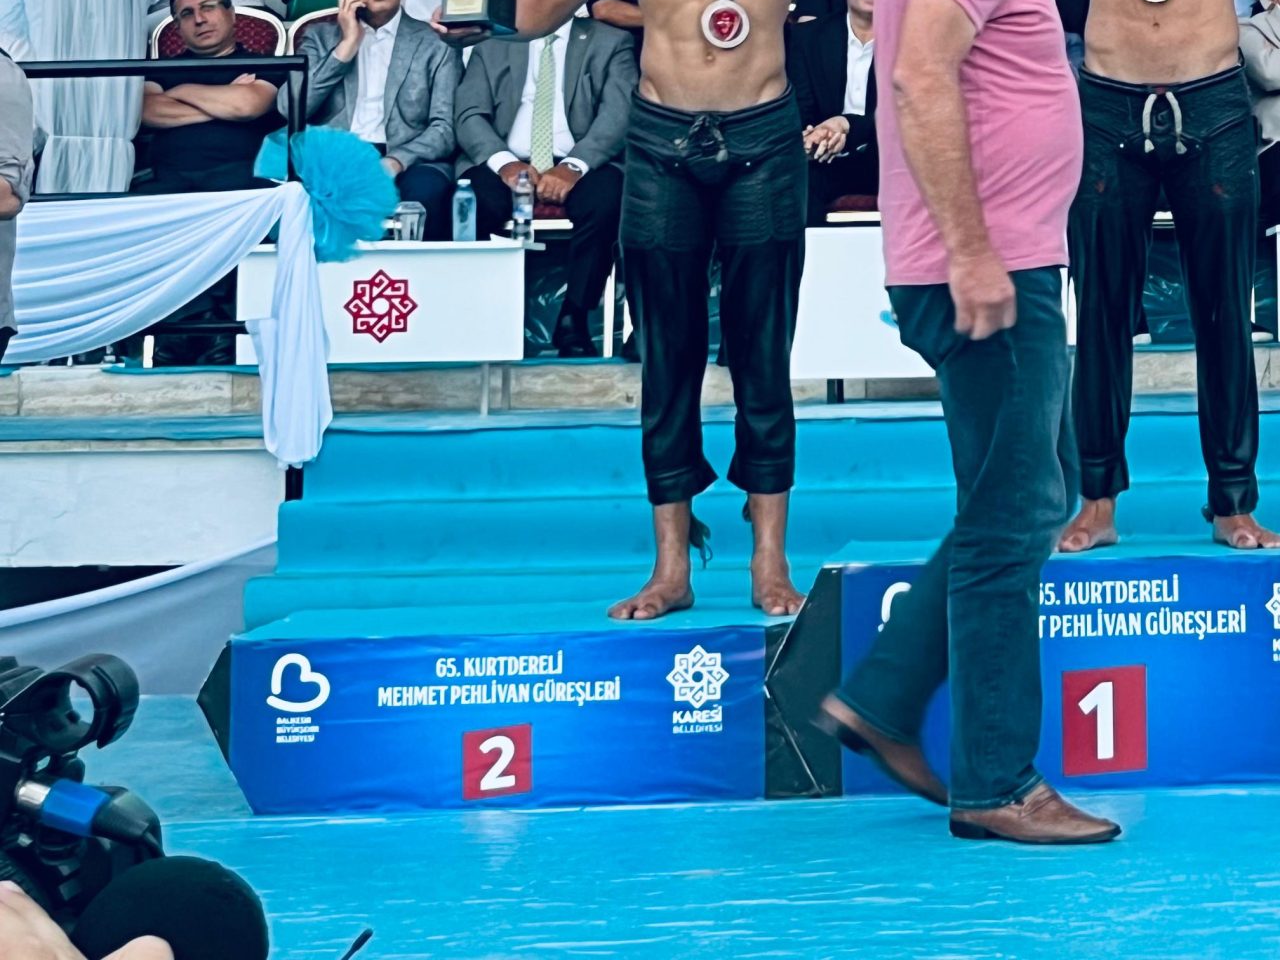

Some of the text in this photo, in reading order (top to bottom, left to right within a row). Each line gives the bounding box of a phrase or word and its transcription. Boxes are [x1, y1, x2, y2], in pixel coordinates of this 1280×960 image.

[1064, 574, 1179, 605] KURTDERELİ
[1049, 608, 1142, 638] PEHLİVAN
[1145, 604, 1246, 641] GÜREŞLERİ
[435, 650, 563, 678] 65. KURTDERELİ
[378, 675, 621, 707] MEHMET PEHLİVAN GÜREŞLERİ
[672, 704, 722, 724] KARESİ
[1078, 681, 1114, 760] 1
[479, 735, 516, 790] 2
